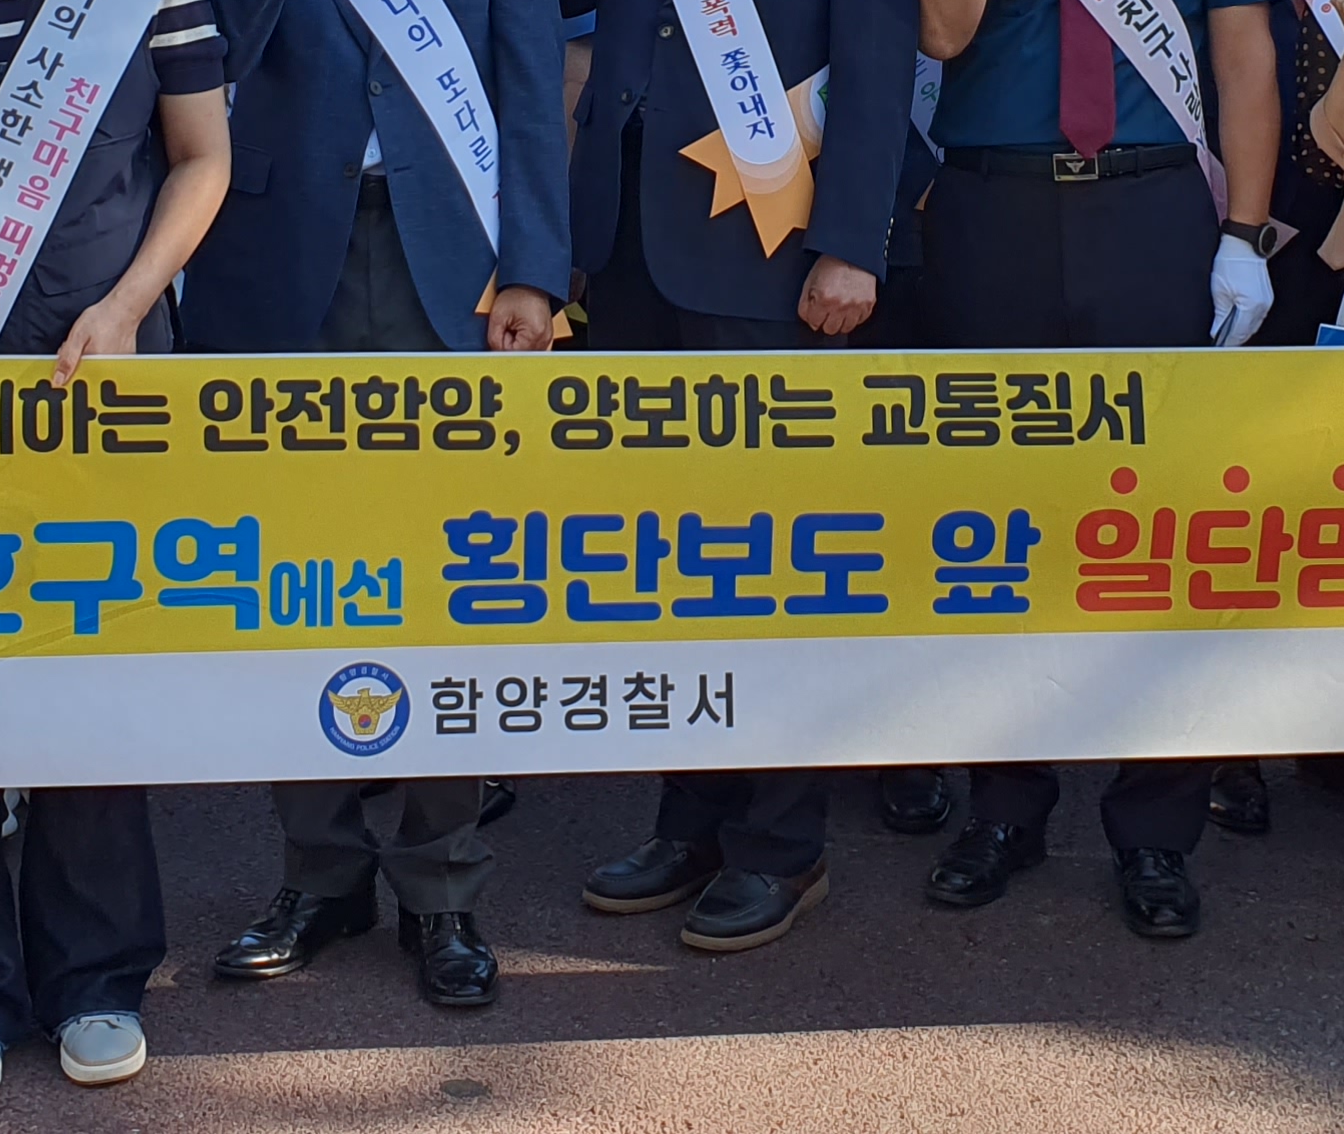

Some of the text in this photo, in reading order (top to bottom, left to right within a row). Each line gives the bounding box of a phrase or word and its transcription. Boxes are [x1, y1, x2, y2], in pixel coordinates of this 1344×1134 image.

[0, 45, 64, 146] 사소한
[17, 76, 101, 211] 친구마음
[436, 67, 496, 173] 또다른
[720, 47, 776, 140] 쫓아내자
[198, 375, 522, 457] 안전함양,
[547, 373, 837, 451] 양보하는
[861, 370, 1146, 447] 교통질서
[441, 509, 891, 626] 횡단보도
[932, 506, 1042, 616] 앞
[431, 671, 738, 737] 함양경찰서
